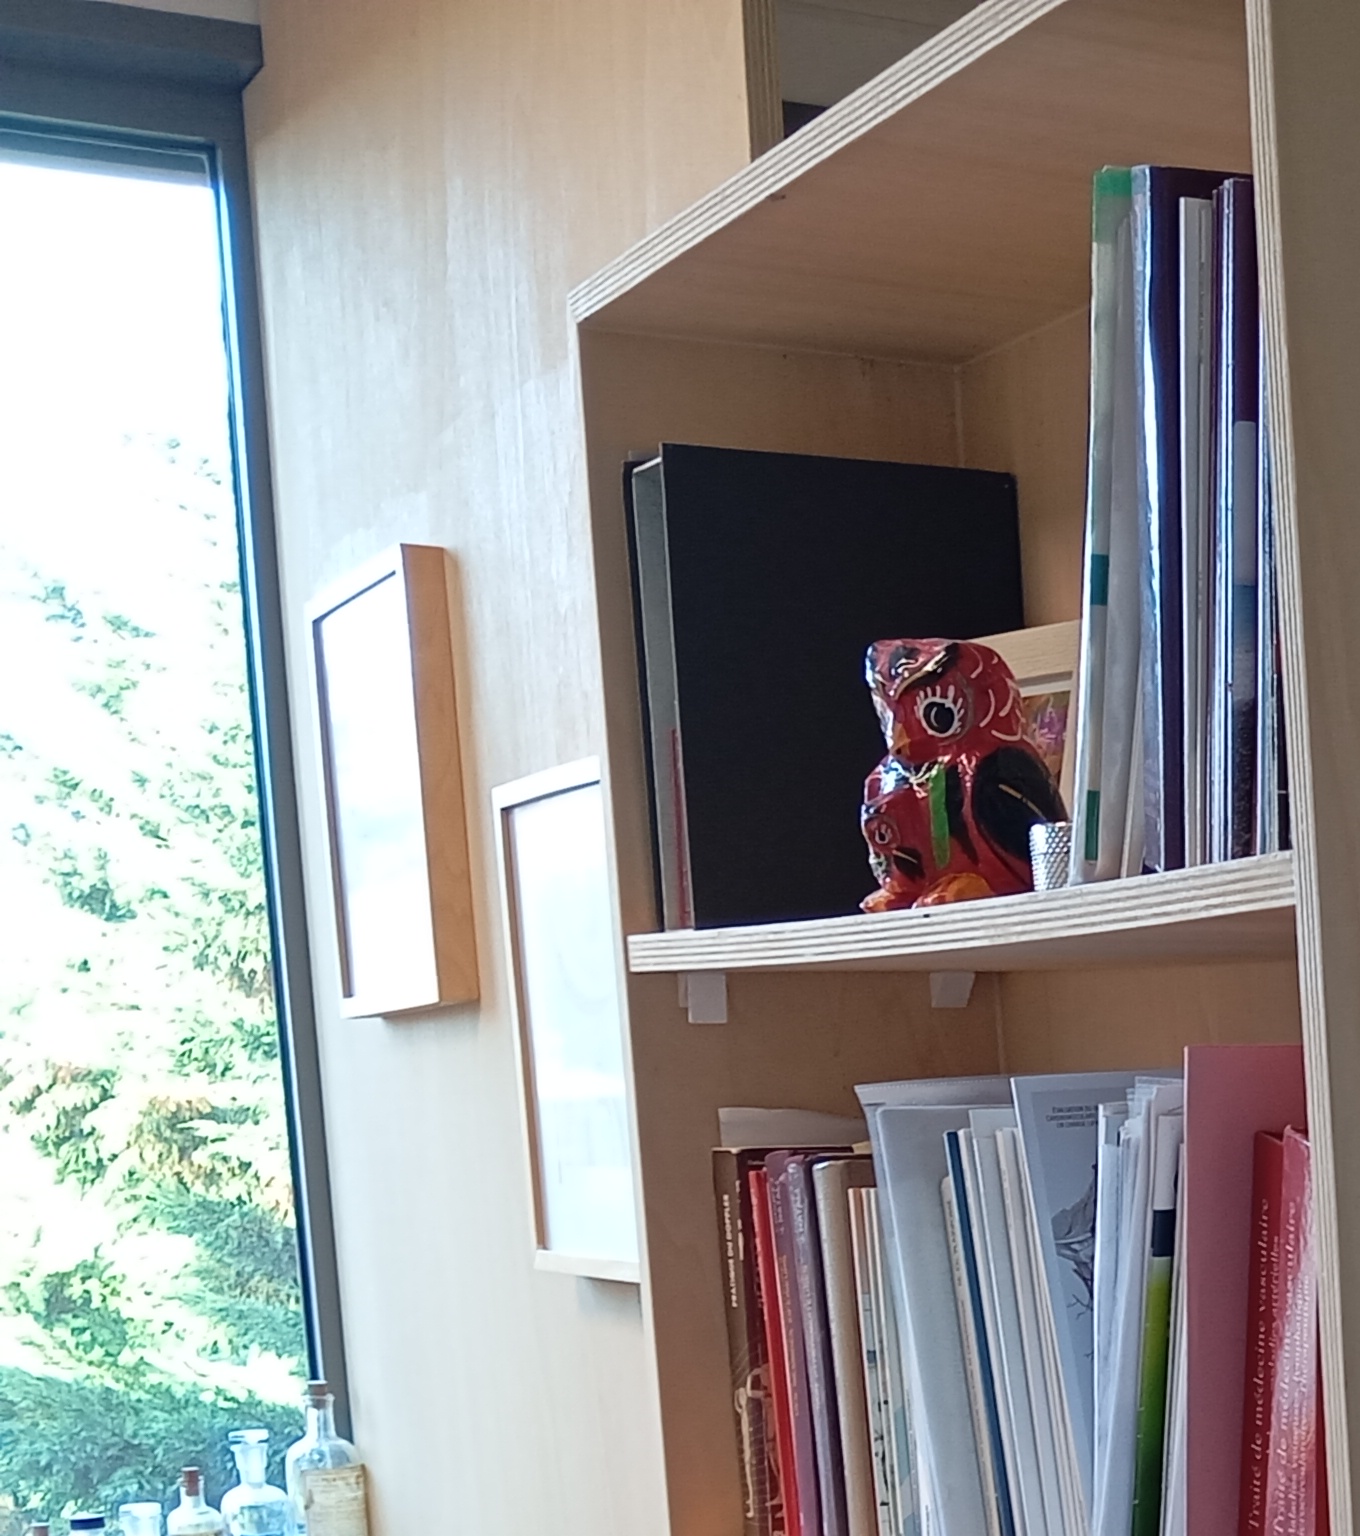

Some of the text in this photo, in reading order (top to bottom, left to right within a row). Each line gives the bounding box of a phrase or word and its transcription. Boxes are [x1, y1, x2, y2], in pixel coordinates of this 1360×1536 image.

[722, 1194, 733, 1240] DOPPLER
[1248, 1198, 1269, 1531] Traité de médecine vasculaire
[1271, 1201, 1296, 1536] Traité de médecine vasculaire
